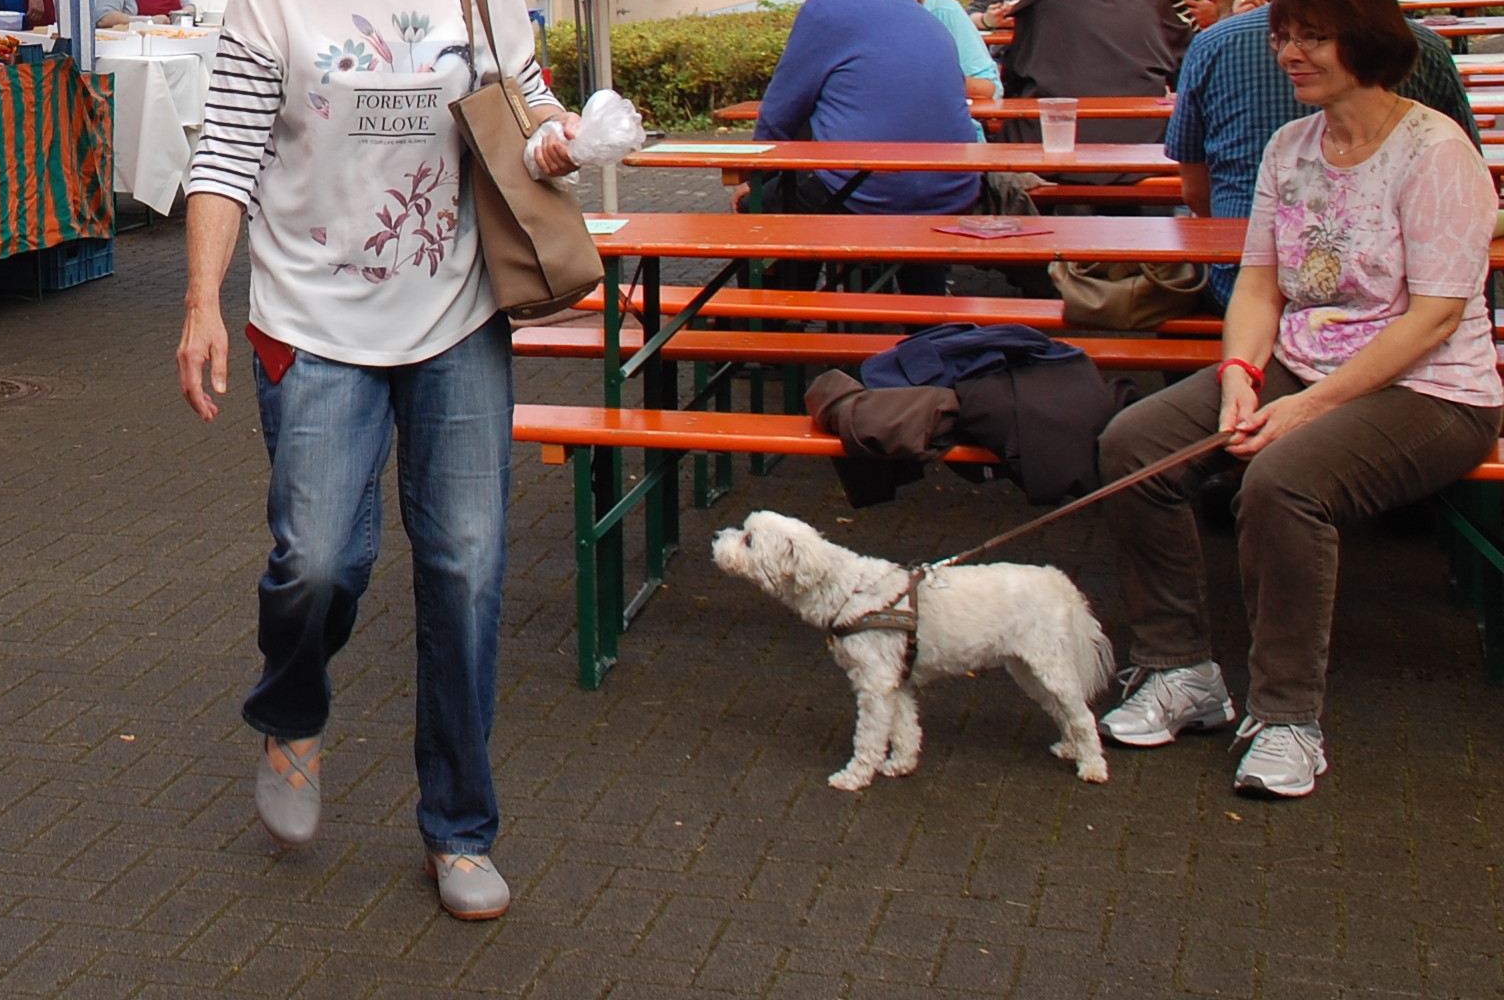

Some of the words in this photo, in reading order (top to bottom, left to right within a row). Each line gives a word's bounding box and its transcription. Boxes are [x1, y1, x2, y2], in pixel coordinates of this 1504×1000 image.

[356, 93, 438, 109] FOREVER
[358, 116, 376, 131] IN
[381, 115, 430, 132] LOVE
